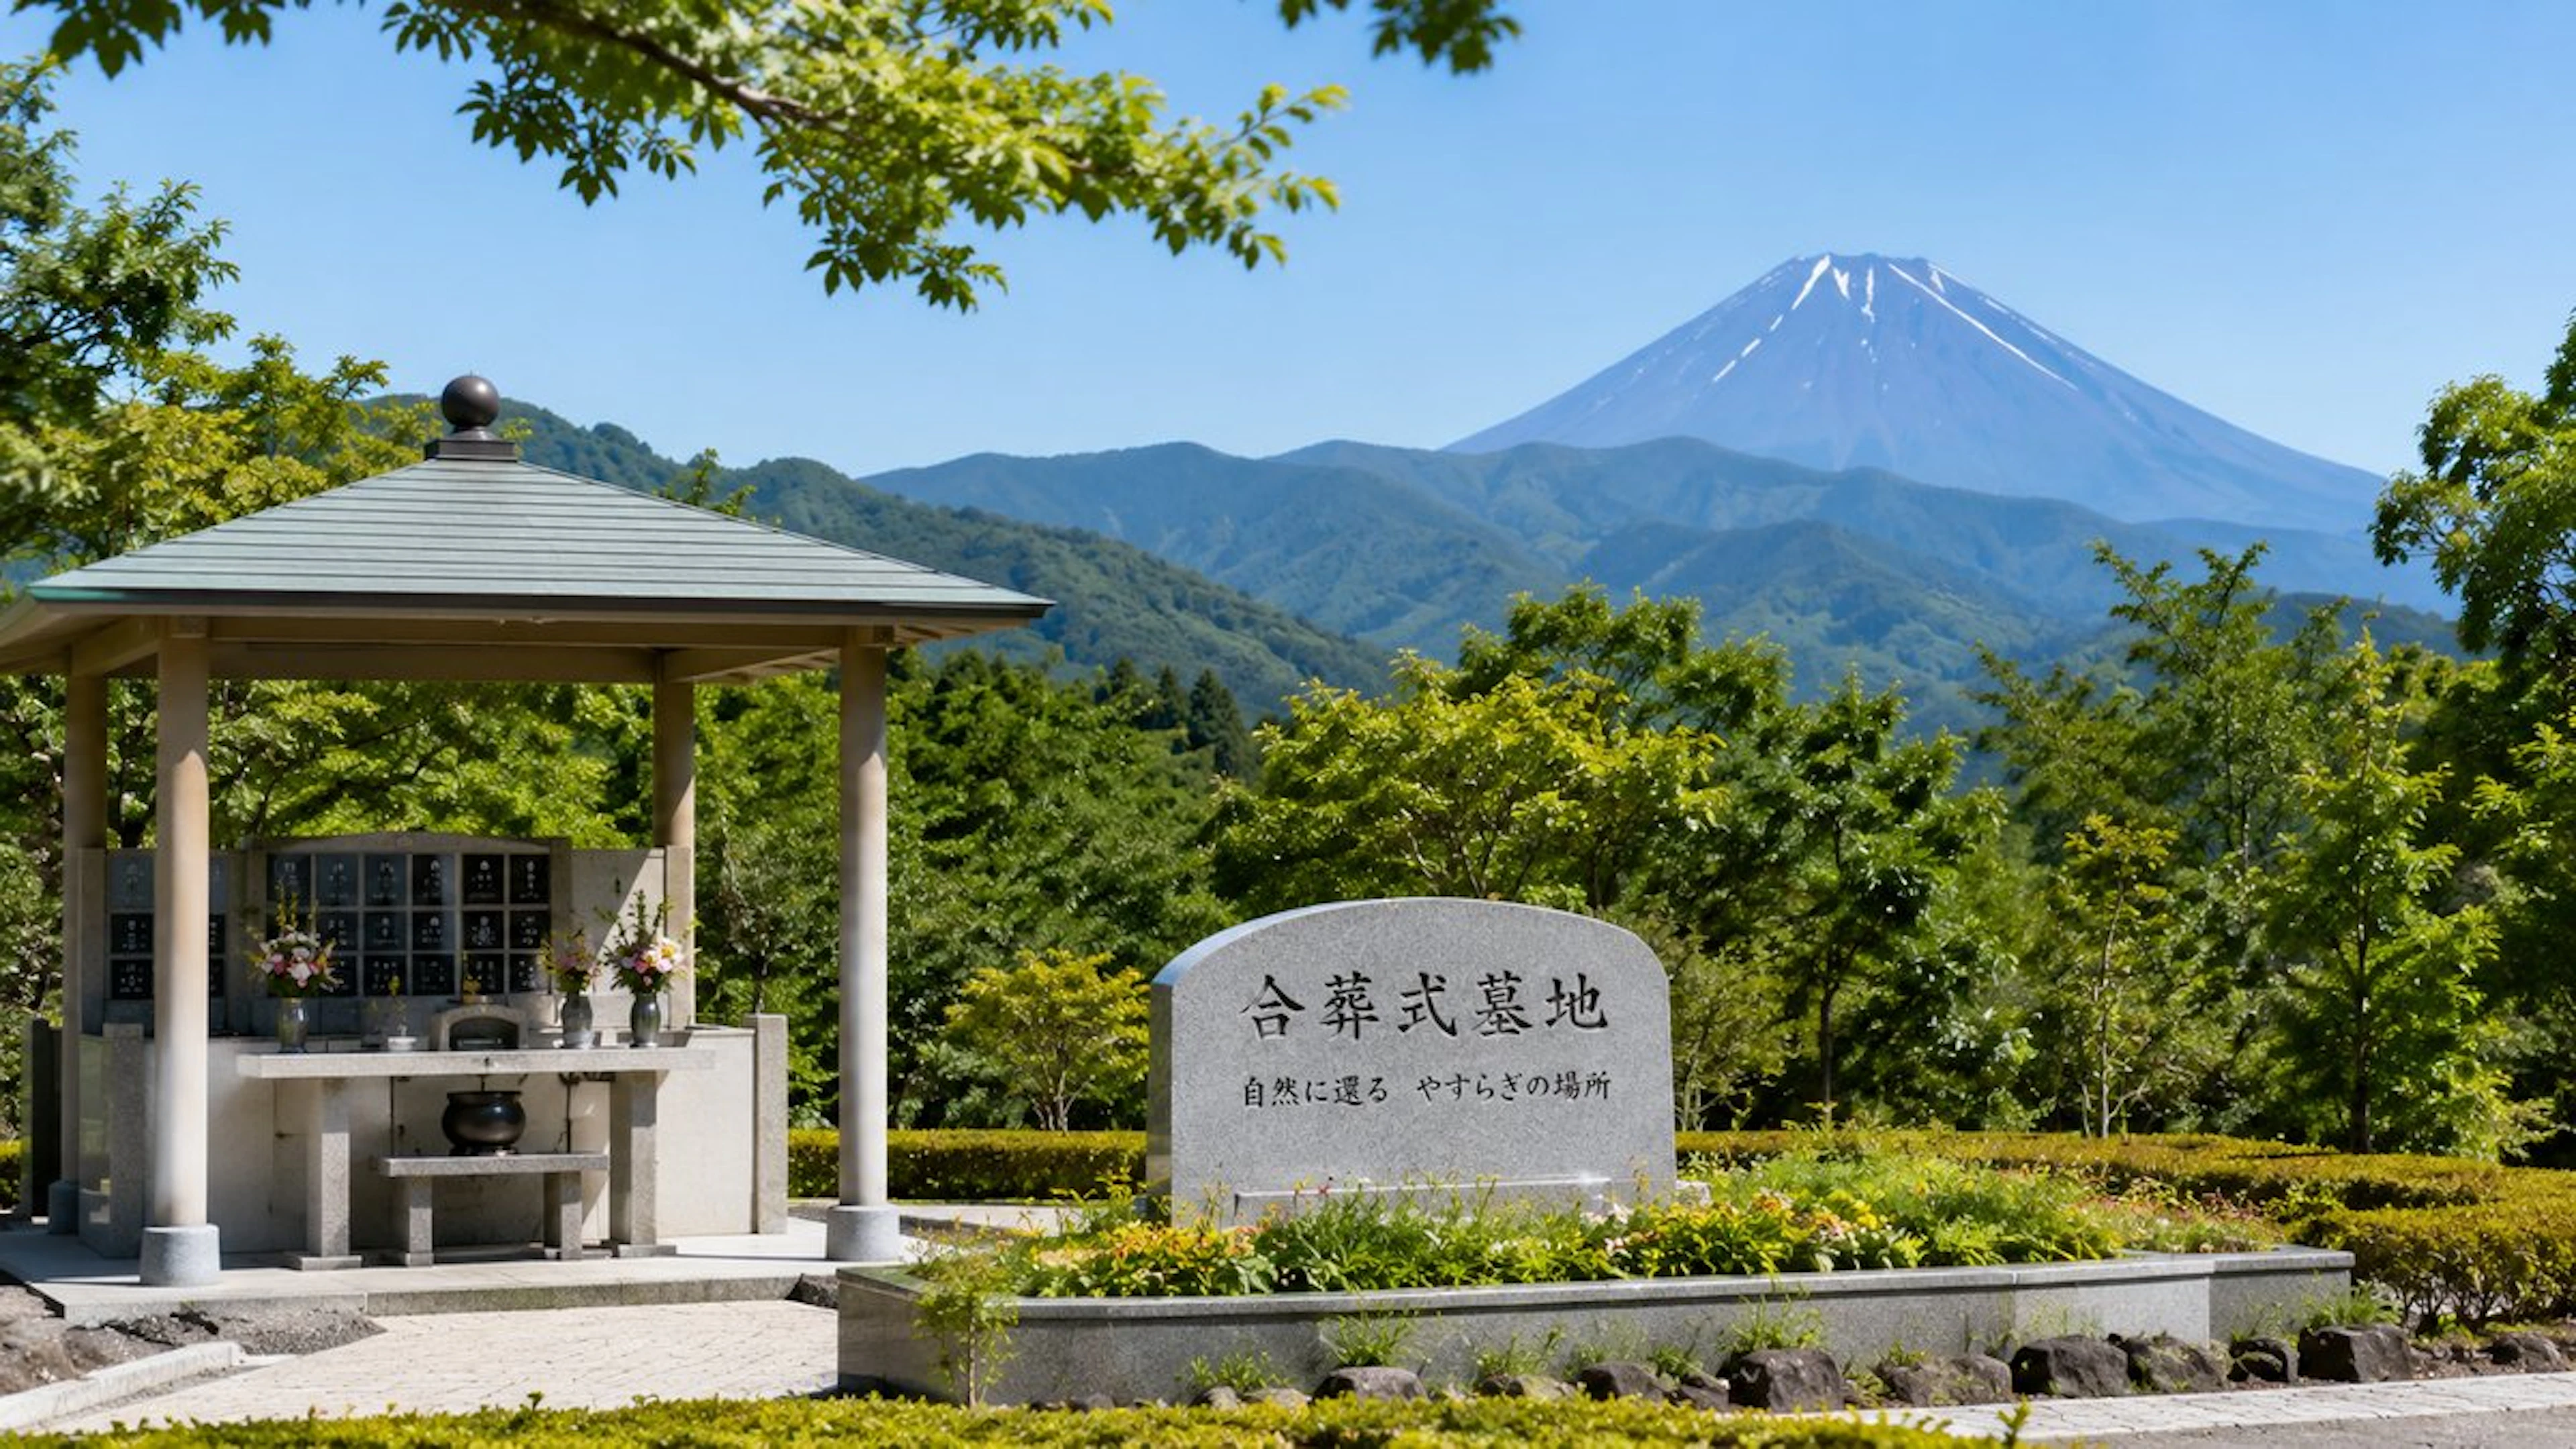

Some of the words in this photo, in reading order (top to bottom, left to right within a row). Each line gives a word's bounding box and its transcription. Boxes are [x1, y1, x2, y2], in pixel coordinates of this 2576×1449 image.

[1241, 970, 1608, 1040] 合葬式墓地
[1245, 1075, 1387, 1108] 自然に還る
[1417, 1071, 1611, 1101] やすらぎの場所
